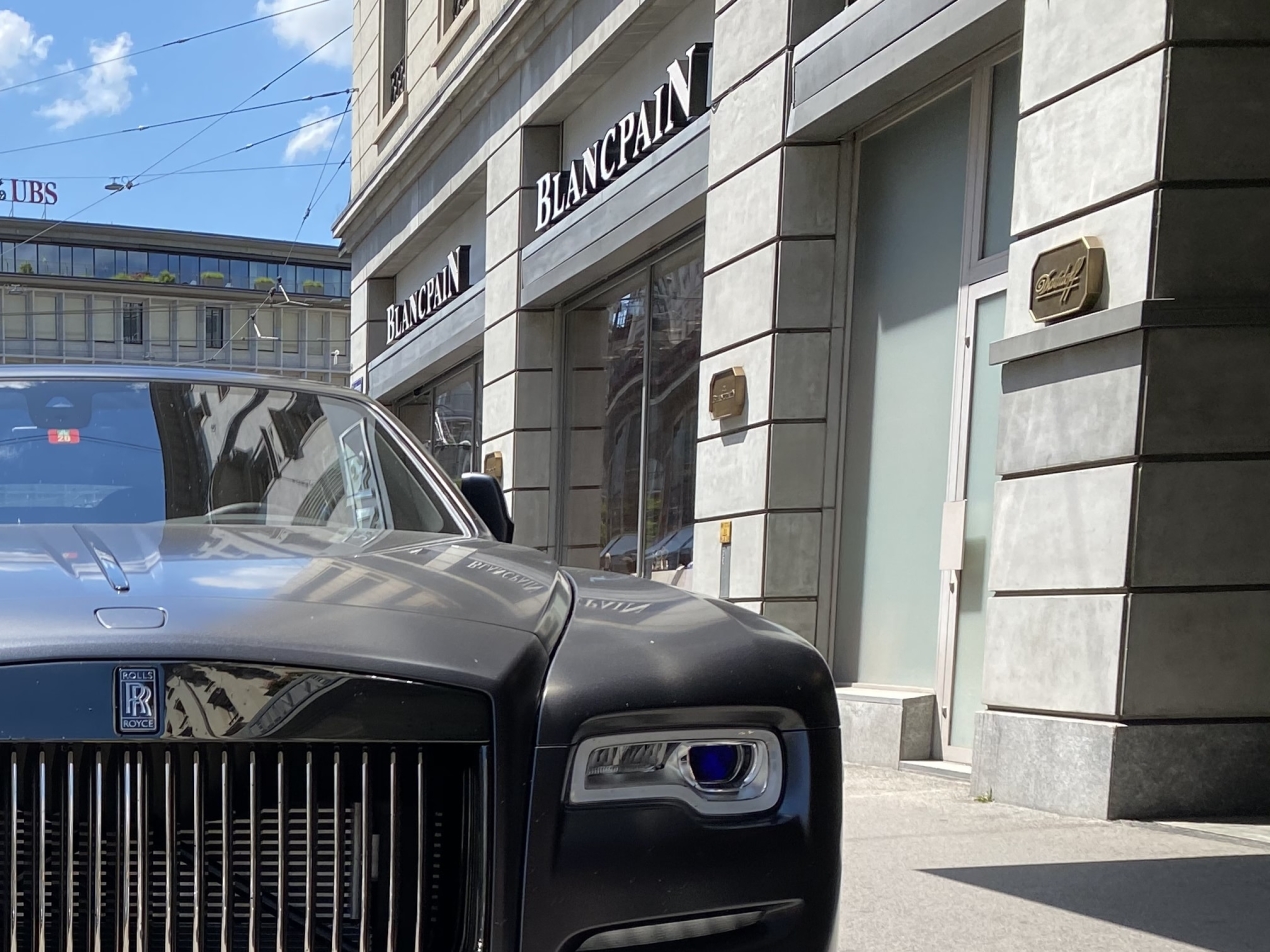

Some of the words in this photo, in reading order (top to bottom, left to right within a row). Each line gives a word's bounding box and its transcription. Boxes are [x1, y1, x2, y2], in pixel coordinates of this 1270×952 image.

[534, 43, 712, 233] BLANCPAIN
[11, 178, 58, 205] UBS
[385, 245, 471, 345] BLANCPAIN
[123, 671, 154, 680] ROLLS
[123, 719, 154, 728] ROYCE
